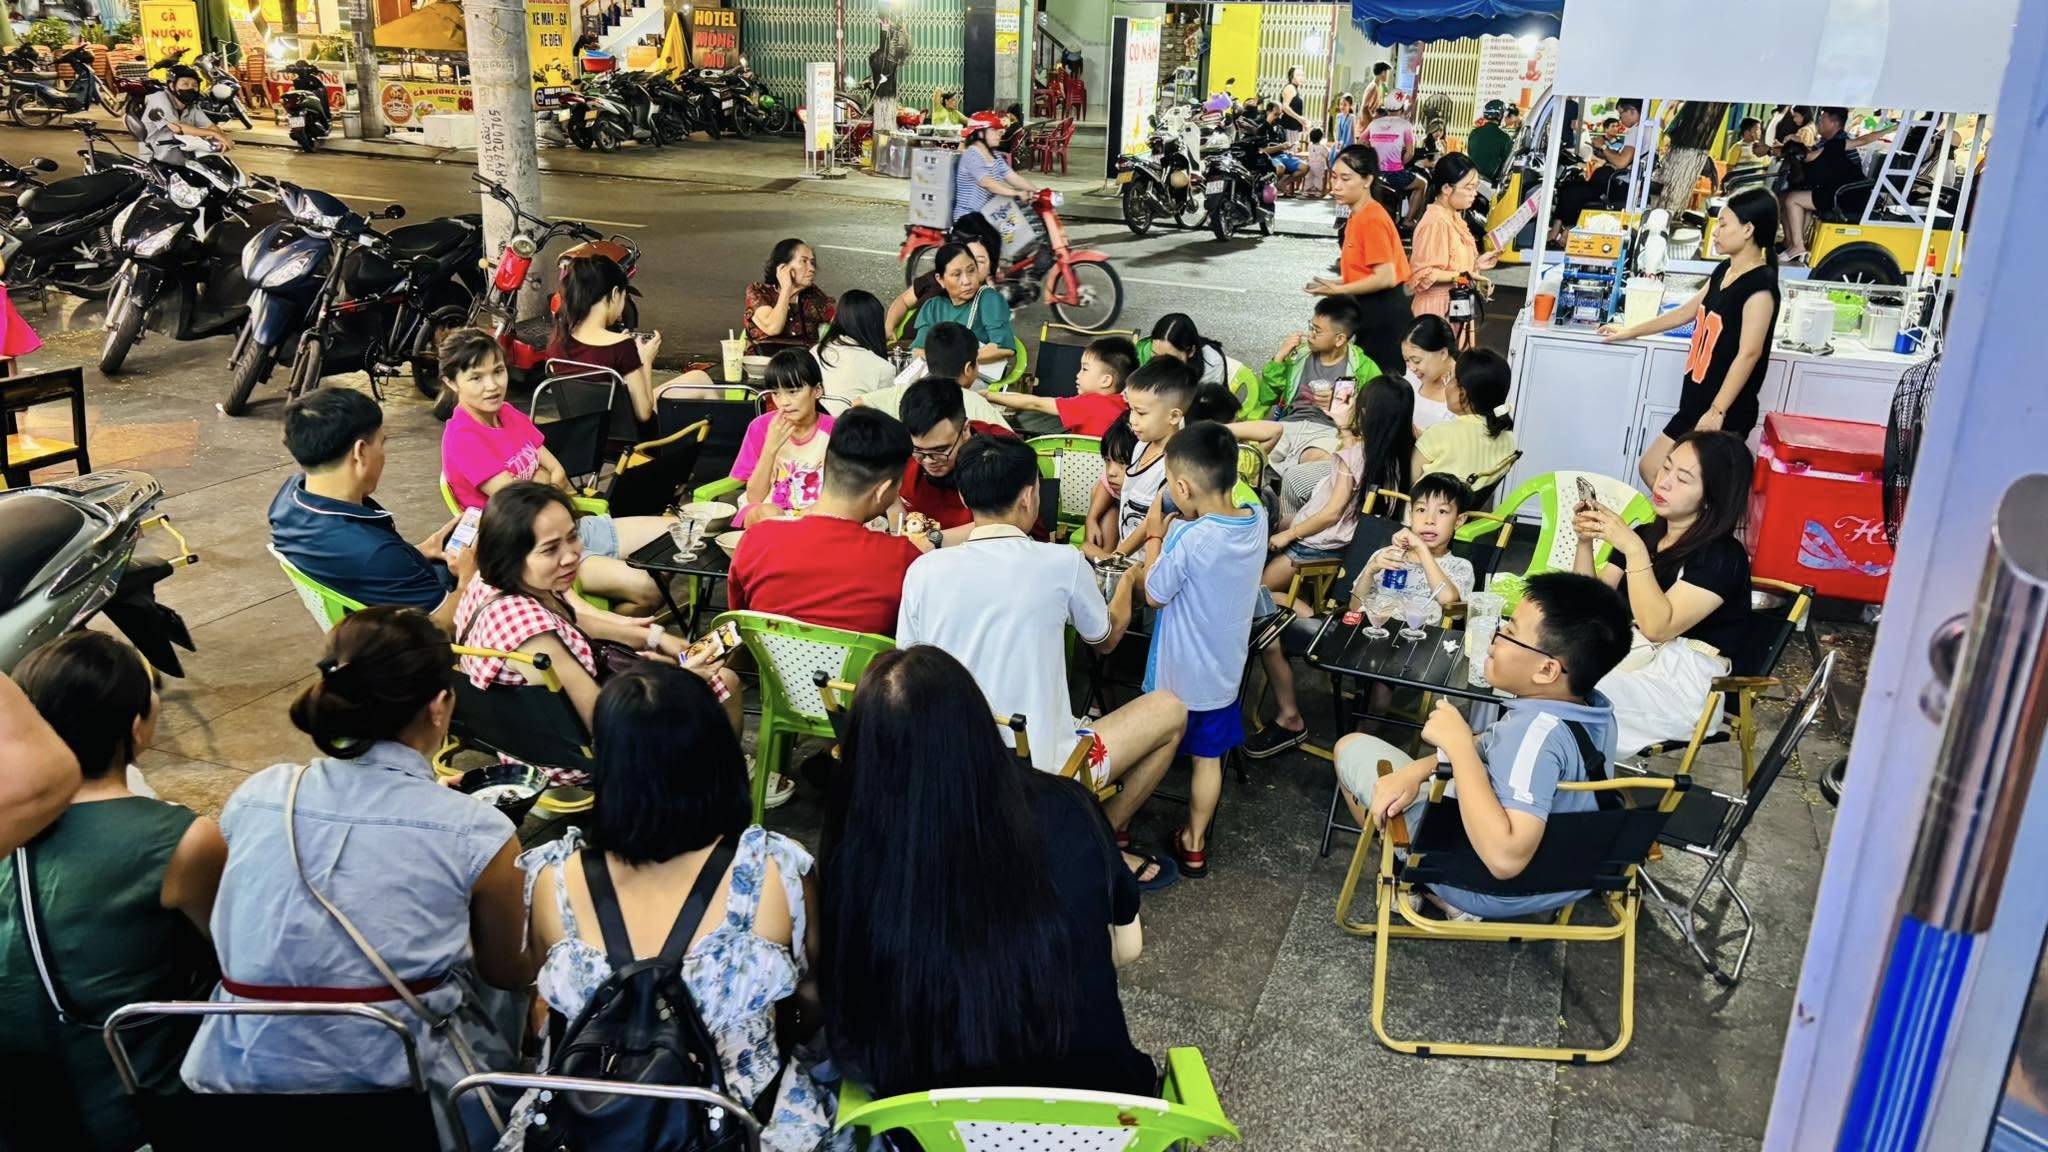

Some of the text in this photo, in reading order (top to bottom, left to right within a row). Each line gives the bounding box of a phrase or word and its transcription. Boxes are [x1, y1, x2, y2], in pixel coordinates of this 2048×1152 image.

[161, 8, 176, 21] GÀ
[533, 13, 540, 25] XE
[695, 10, 737, 27] HOTEL
[541, 34, 548, 46] XE
